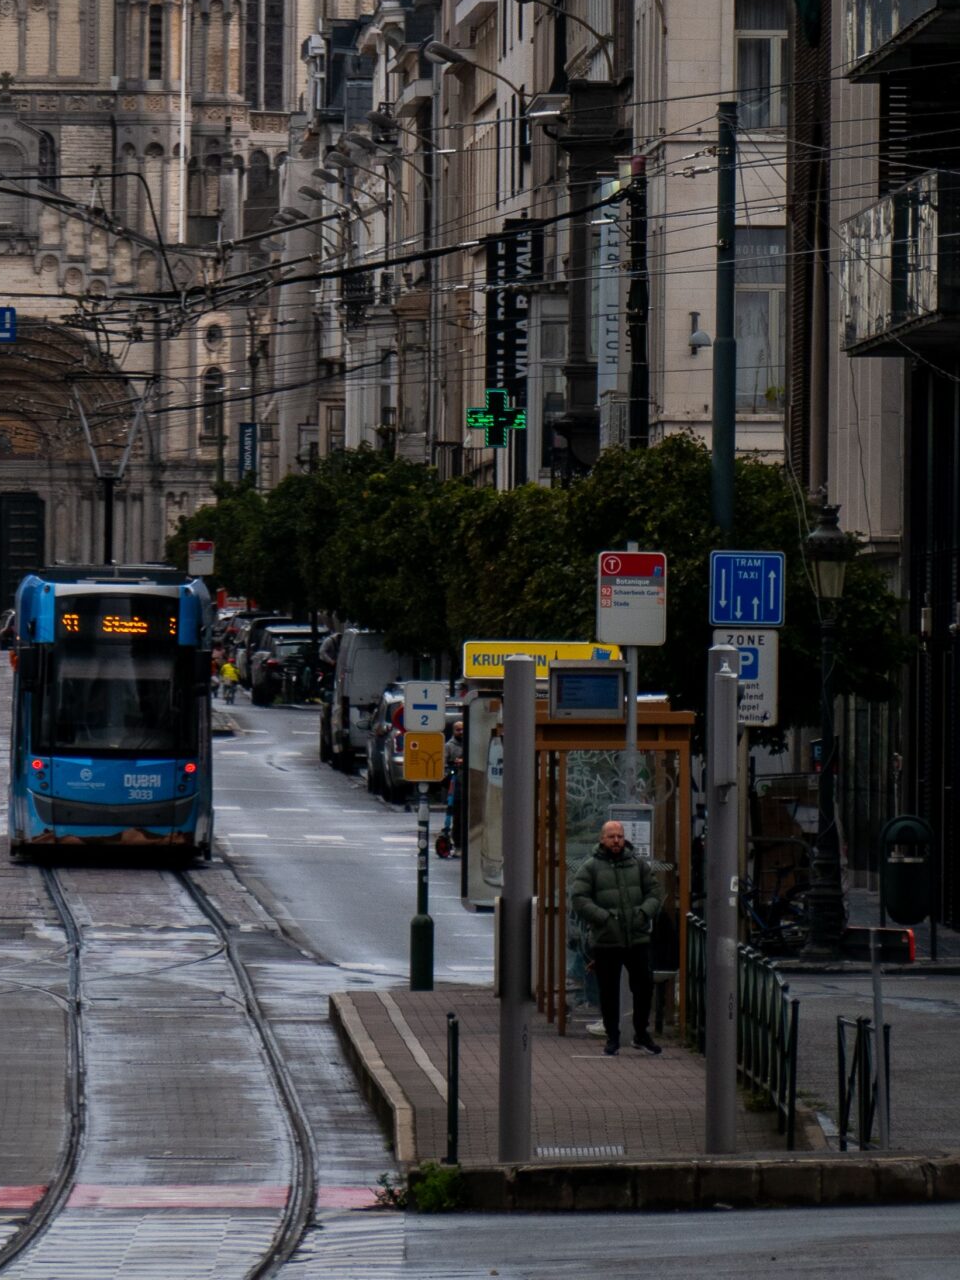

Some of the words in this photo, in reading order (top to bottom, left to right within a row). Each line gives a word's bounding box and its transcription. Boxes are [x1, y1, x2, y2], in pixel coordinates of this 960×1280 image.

[515, 231, 532, 308] RYALE
[515, 320, 528, 378] VILLA
[608, 559, 617, 570] T
[735, 558, 762, 567] TRAM
[737, 571, 759, 579] TAXI
[615, 577, 650, 586] Botanique
[601, 587, 611, 595] 92
[601, 598, 611, 606] 93
[727, 634, 765, 645] ZONE
[422, 689, 428, 699] 1
[421, 715, 429, 726] 2
[123, 774, 161, 788] DUBAI
[127, 789, 153, 800] 3033
